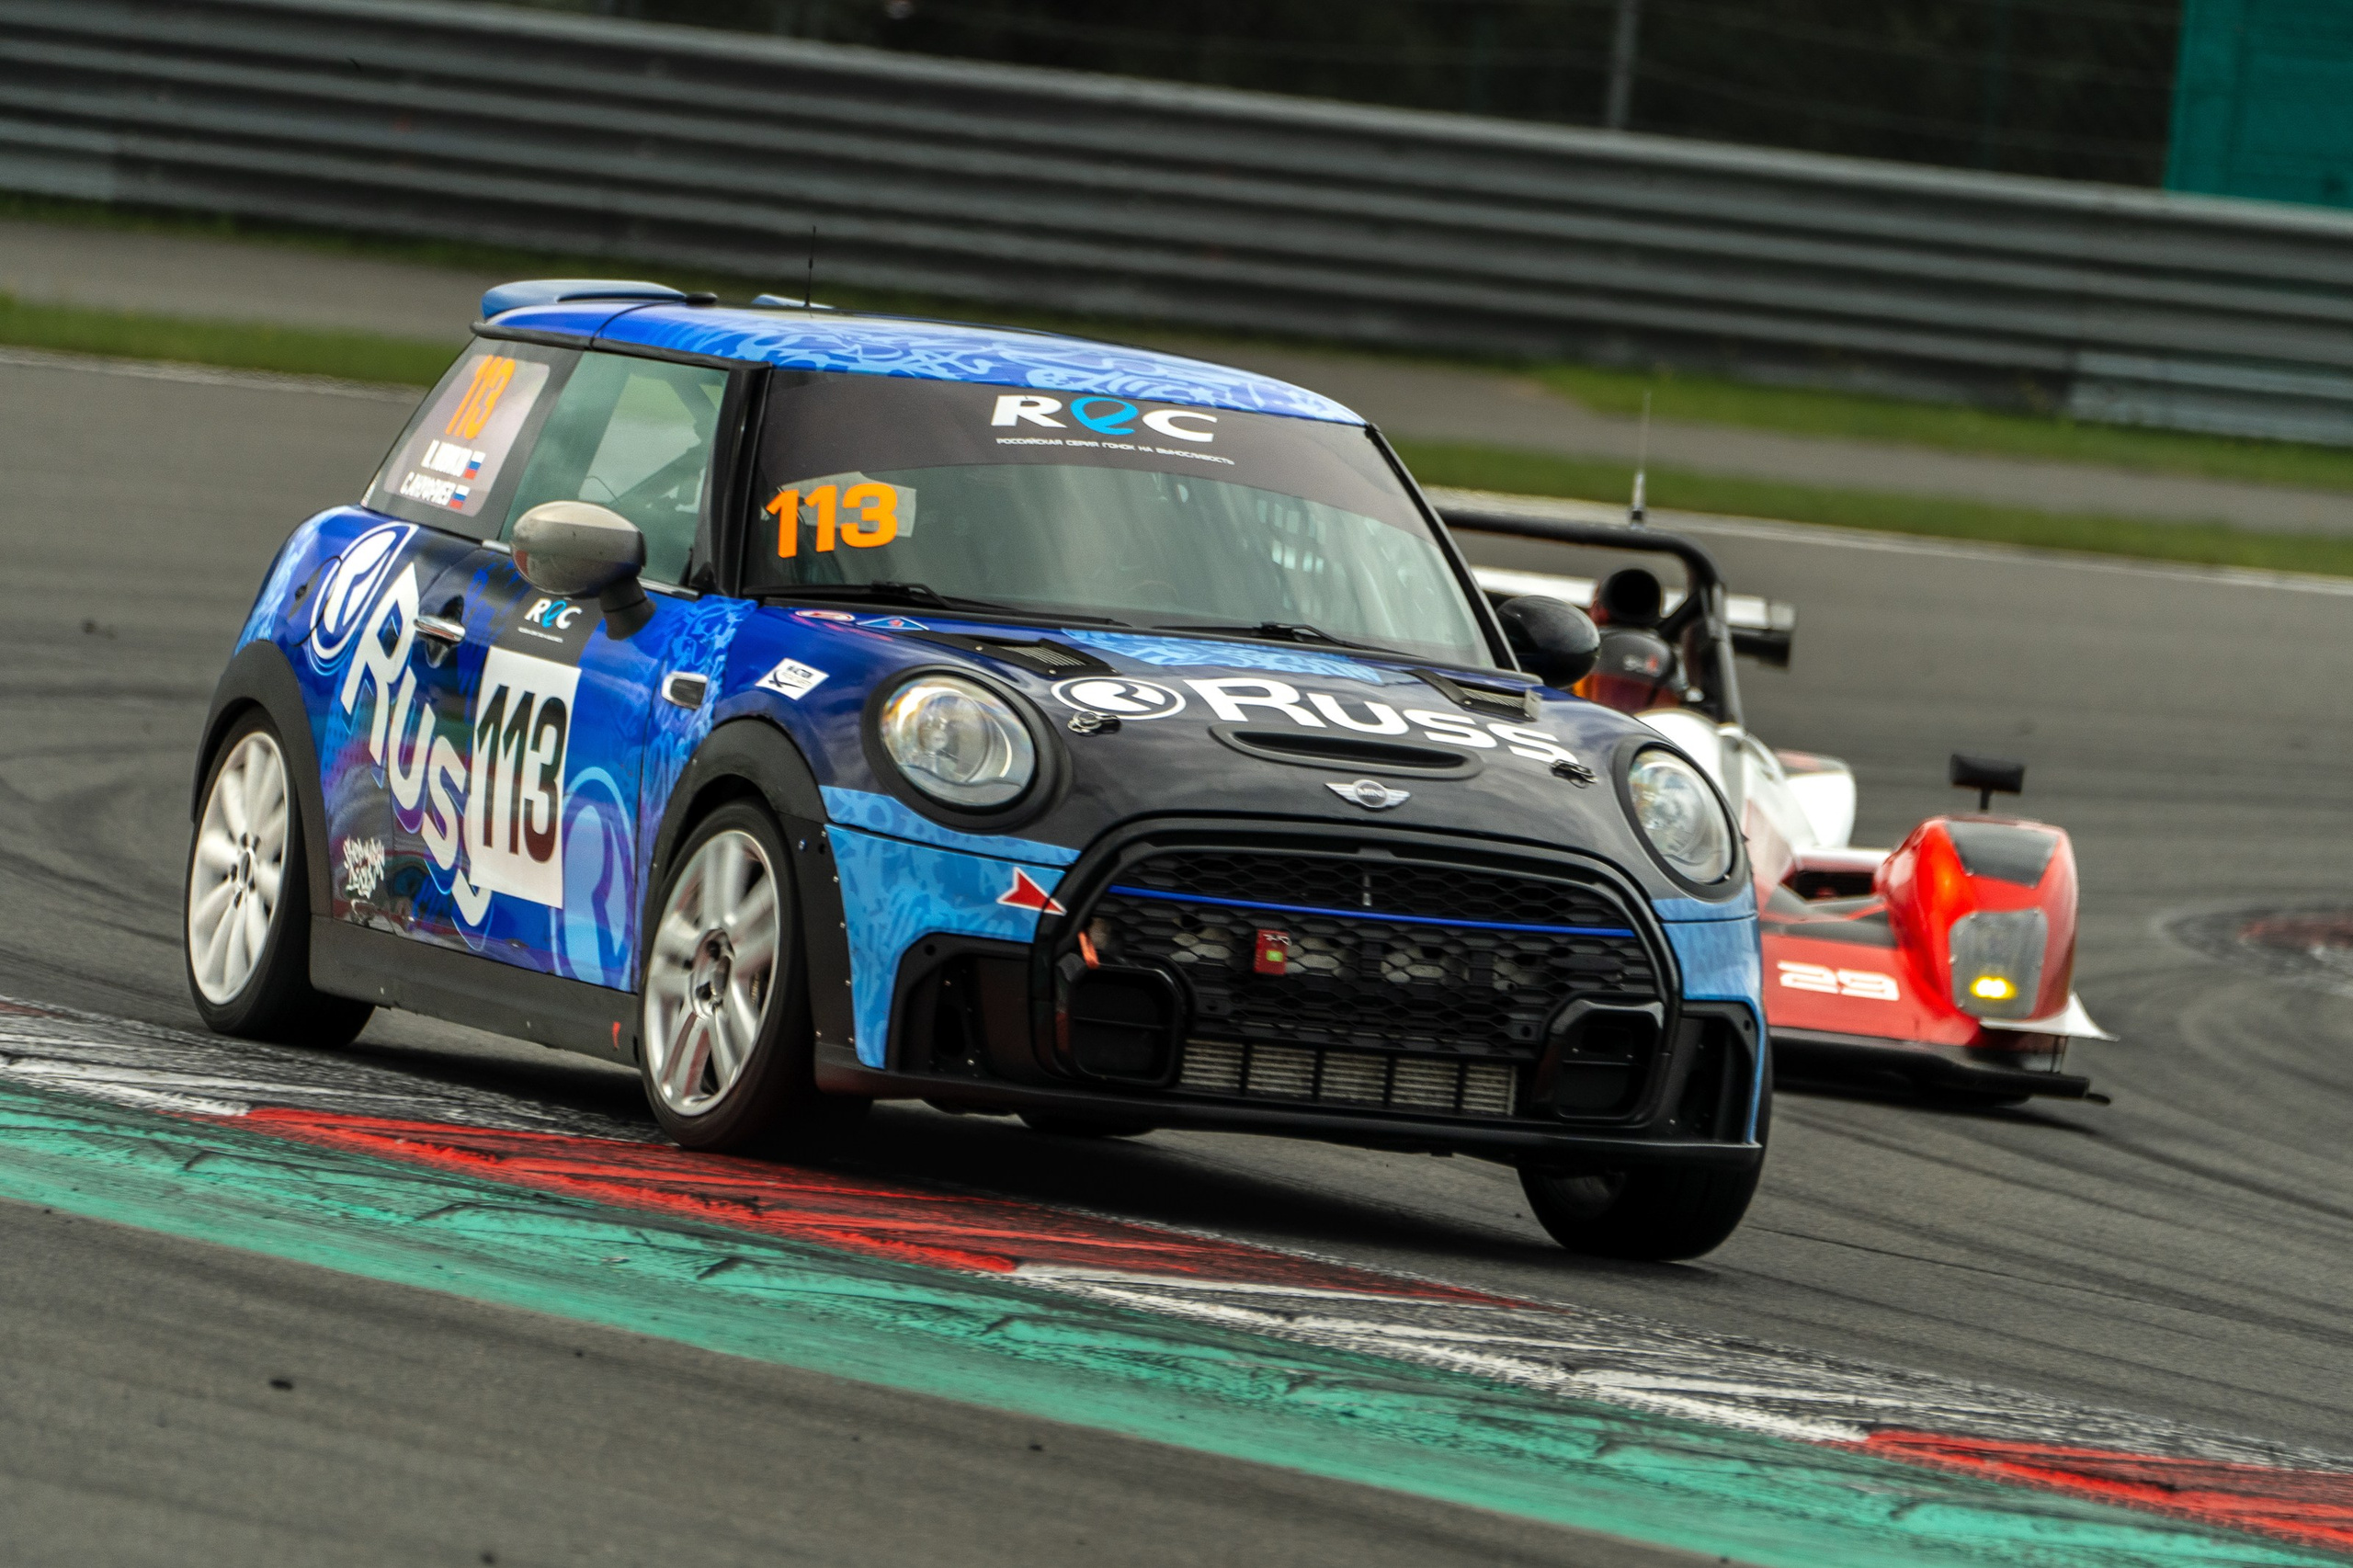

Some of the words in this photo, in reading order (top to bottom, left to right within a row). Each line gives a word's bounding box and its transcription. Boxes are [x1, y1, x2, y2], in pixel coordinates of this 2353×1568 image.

[445, 355, 517, 439] 113
[766, 483, 898, 558] 113
[474, 683, 567, 864] 113
[1777, 960, 1900, 1001] 29
